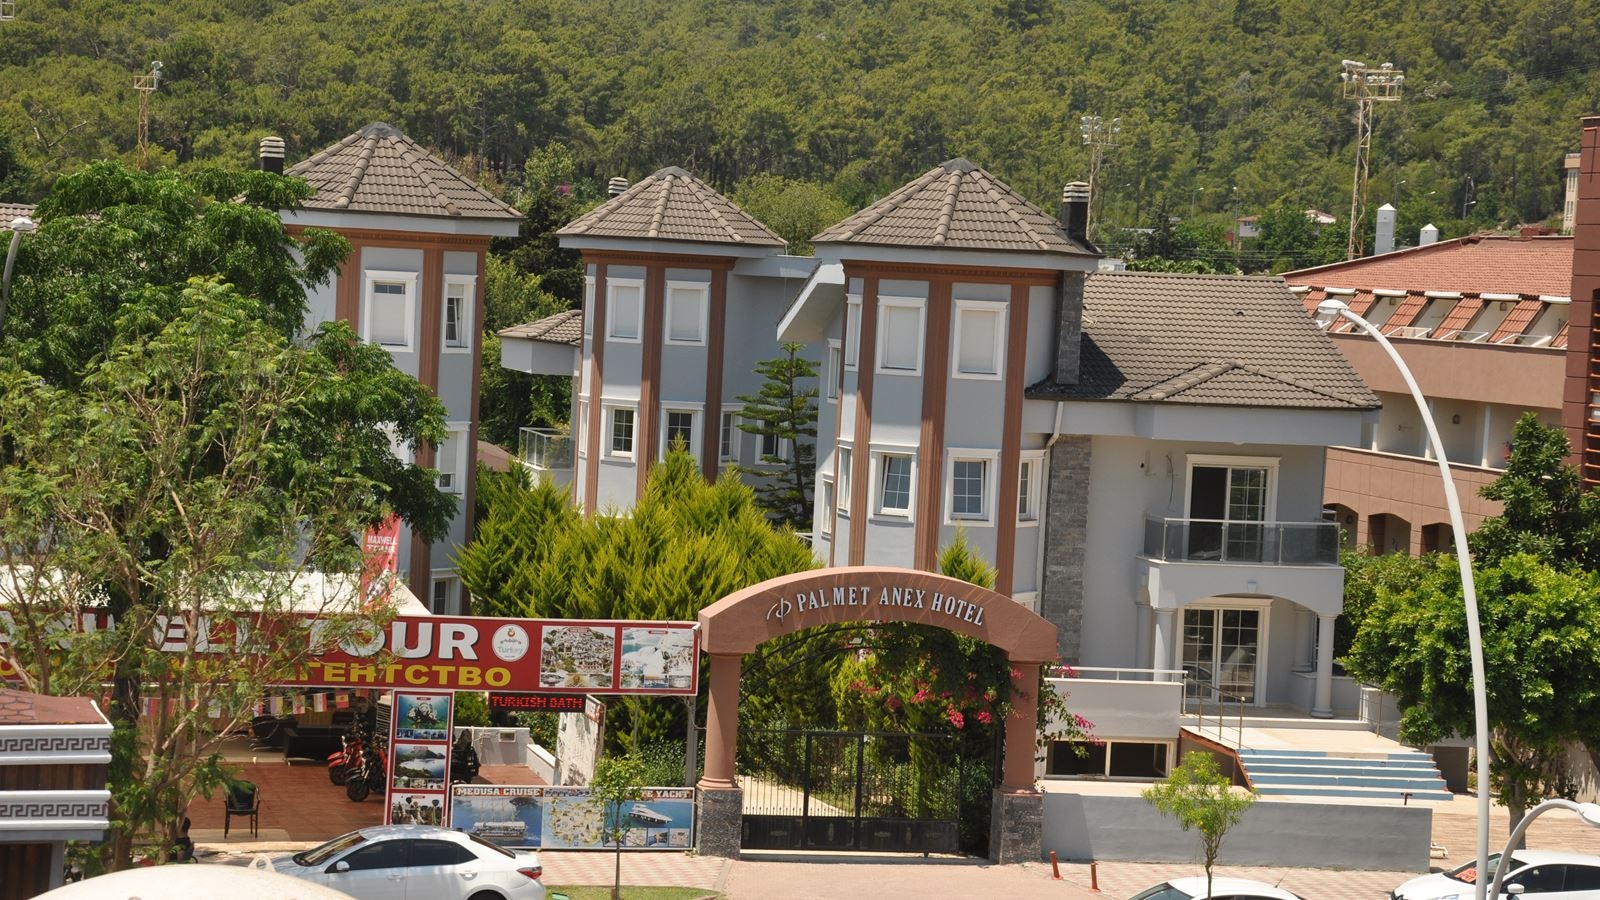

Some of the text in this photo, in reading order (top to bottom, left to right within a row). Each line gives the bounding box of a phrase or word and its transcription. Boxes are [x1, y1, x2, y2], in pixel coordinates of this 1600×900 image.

[367, 535, 397, 545] MAXWELL
[797, 587, 984, 626] PALMET ANEX HOTEL
[302, 618, 479, 660] TOUR
[492, 696, 582, 709] TURKISH BATH
[457, 787, 500, 796] MEDUSA
[503, 787, 540, 796] CRUISE
[656, 790, 688, 798] YACHT
